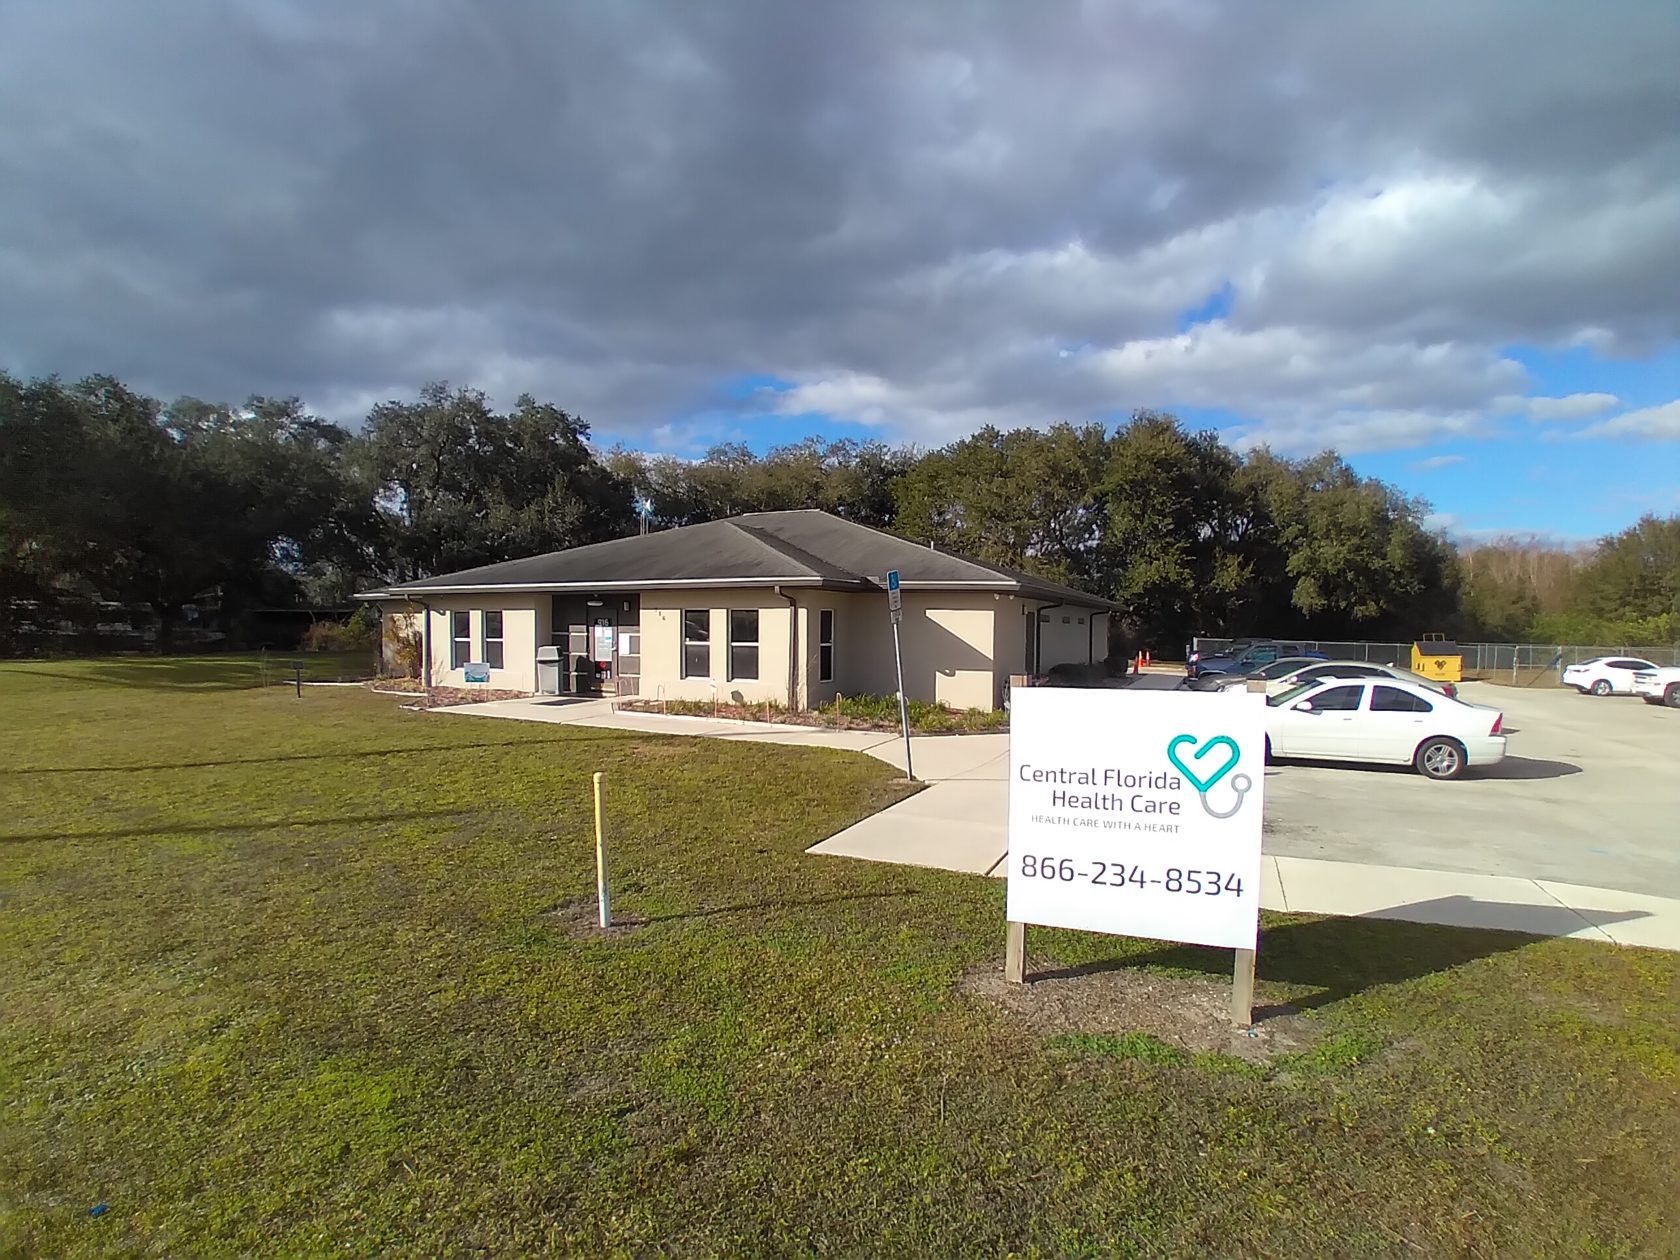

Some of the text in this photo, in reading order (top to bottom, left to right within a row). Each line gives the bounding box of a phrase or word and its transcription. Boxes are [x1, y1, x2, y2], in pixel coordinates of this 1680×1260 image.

[597, 618, 609, 627] 916
[1019, 764, 1181, 790] Central Florida
[1053, 790, 1181, 815] Health Care
[1031, 815, 1180, 834] HEALTH CARE WITH A HEART
[1021, 854, 1244, 898] 866-234-8534
